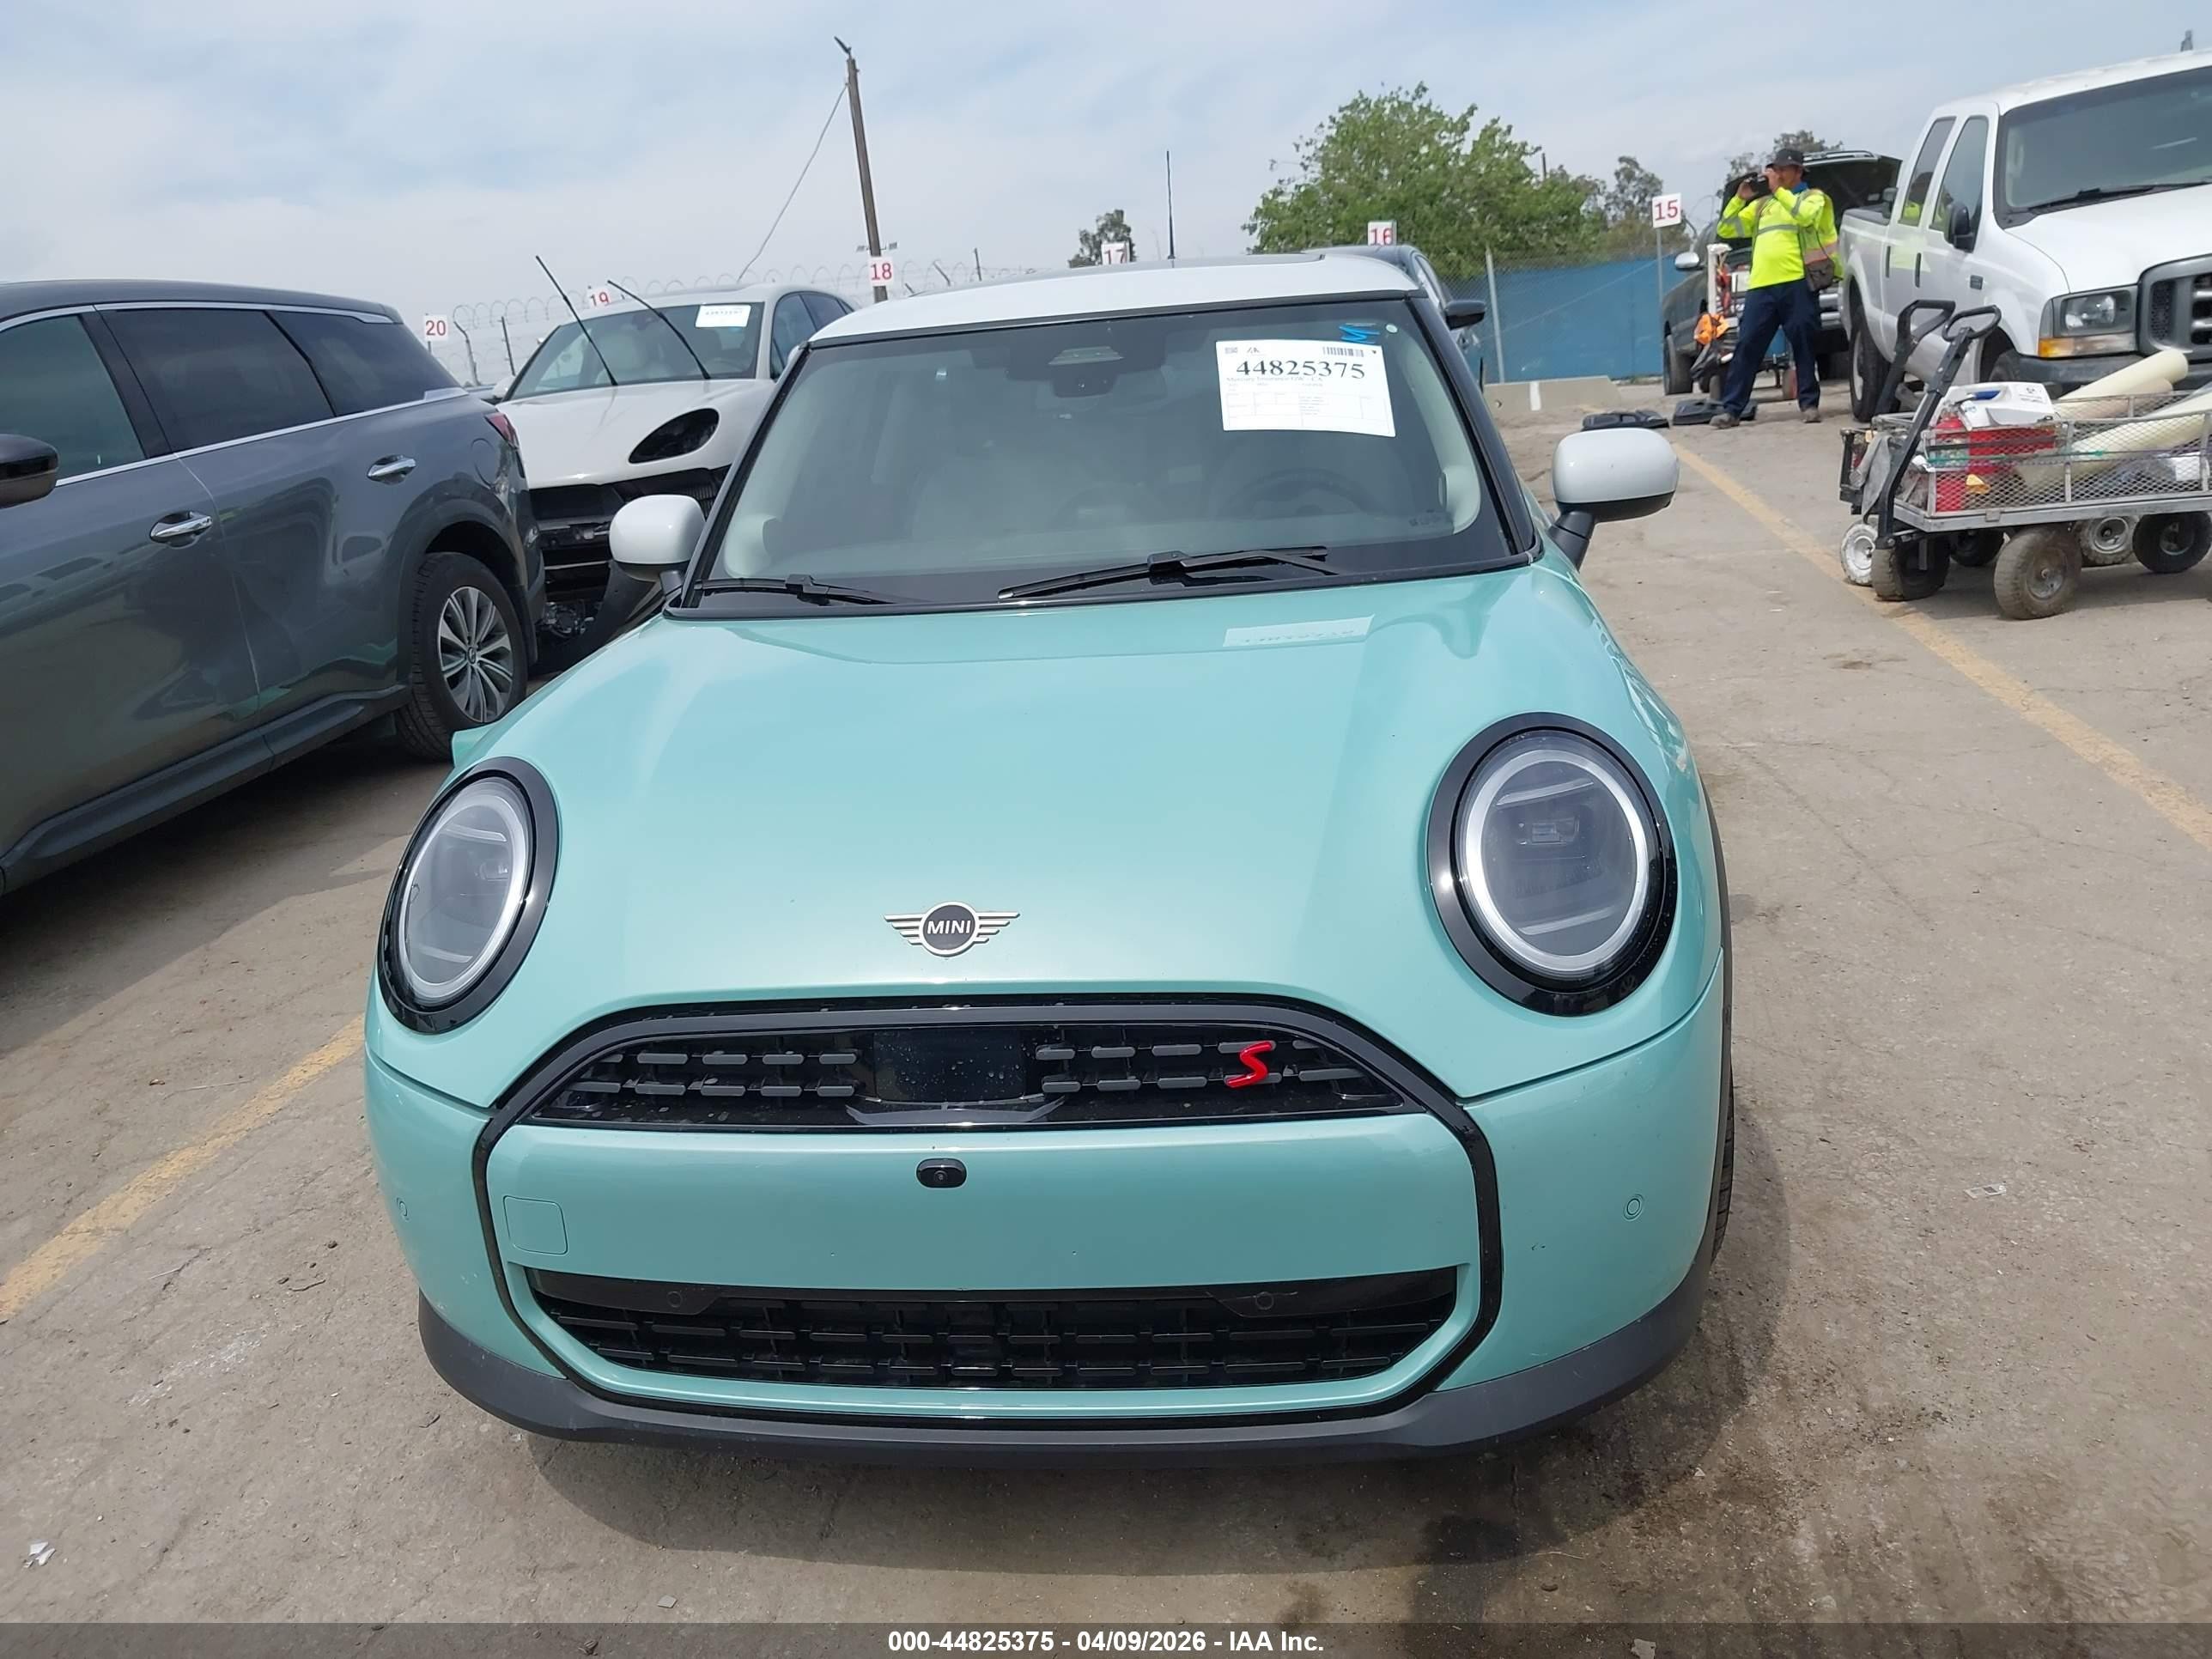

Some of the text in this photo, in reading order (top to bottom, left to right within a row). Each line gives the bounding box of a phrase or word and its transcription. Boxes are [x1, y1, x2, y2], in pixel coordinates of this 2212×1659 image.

[1655, 199, 1678, 221] 15
[1370, 228, 1394, 246] 16
[1103, 248, 1127, 264] 17
[871, 262, 892, 281] 18
[590, 291, 610, 307] 19
[425, 320, 447, 336] 20
[1236, 359, 1365, 380] 44825375
[927, 920, 971, 934] MINI
[1224, 1040, 1273, 1089] S
